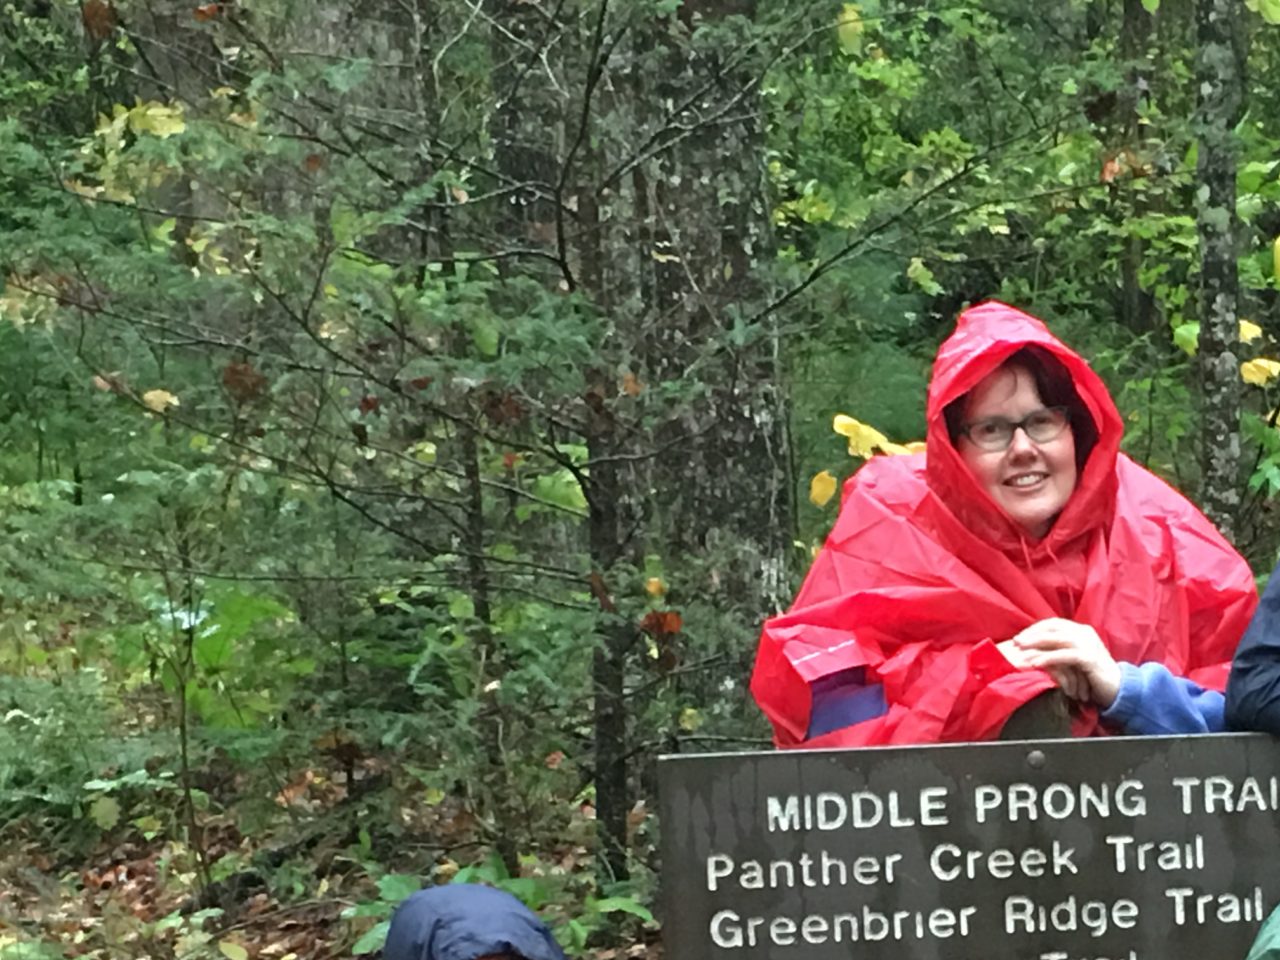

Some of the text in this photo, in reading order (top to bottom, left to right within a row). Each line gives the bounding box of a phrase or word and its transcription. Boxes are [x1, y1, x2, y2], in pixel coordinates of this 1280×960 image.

[766, 786, 949, 833] MIDDLE
[974, 779, 1147, 824] PRONG
[706, 850, 903, 892] Panther
[929, 840, 1079, 882] Creek
[1105, 834, 1205, 873] Trail
[709, 886, 1264, 949] Greenbrier Ridge Trail
